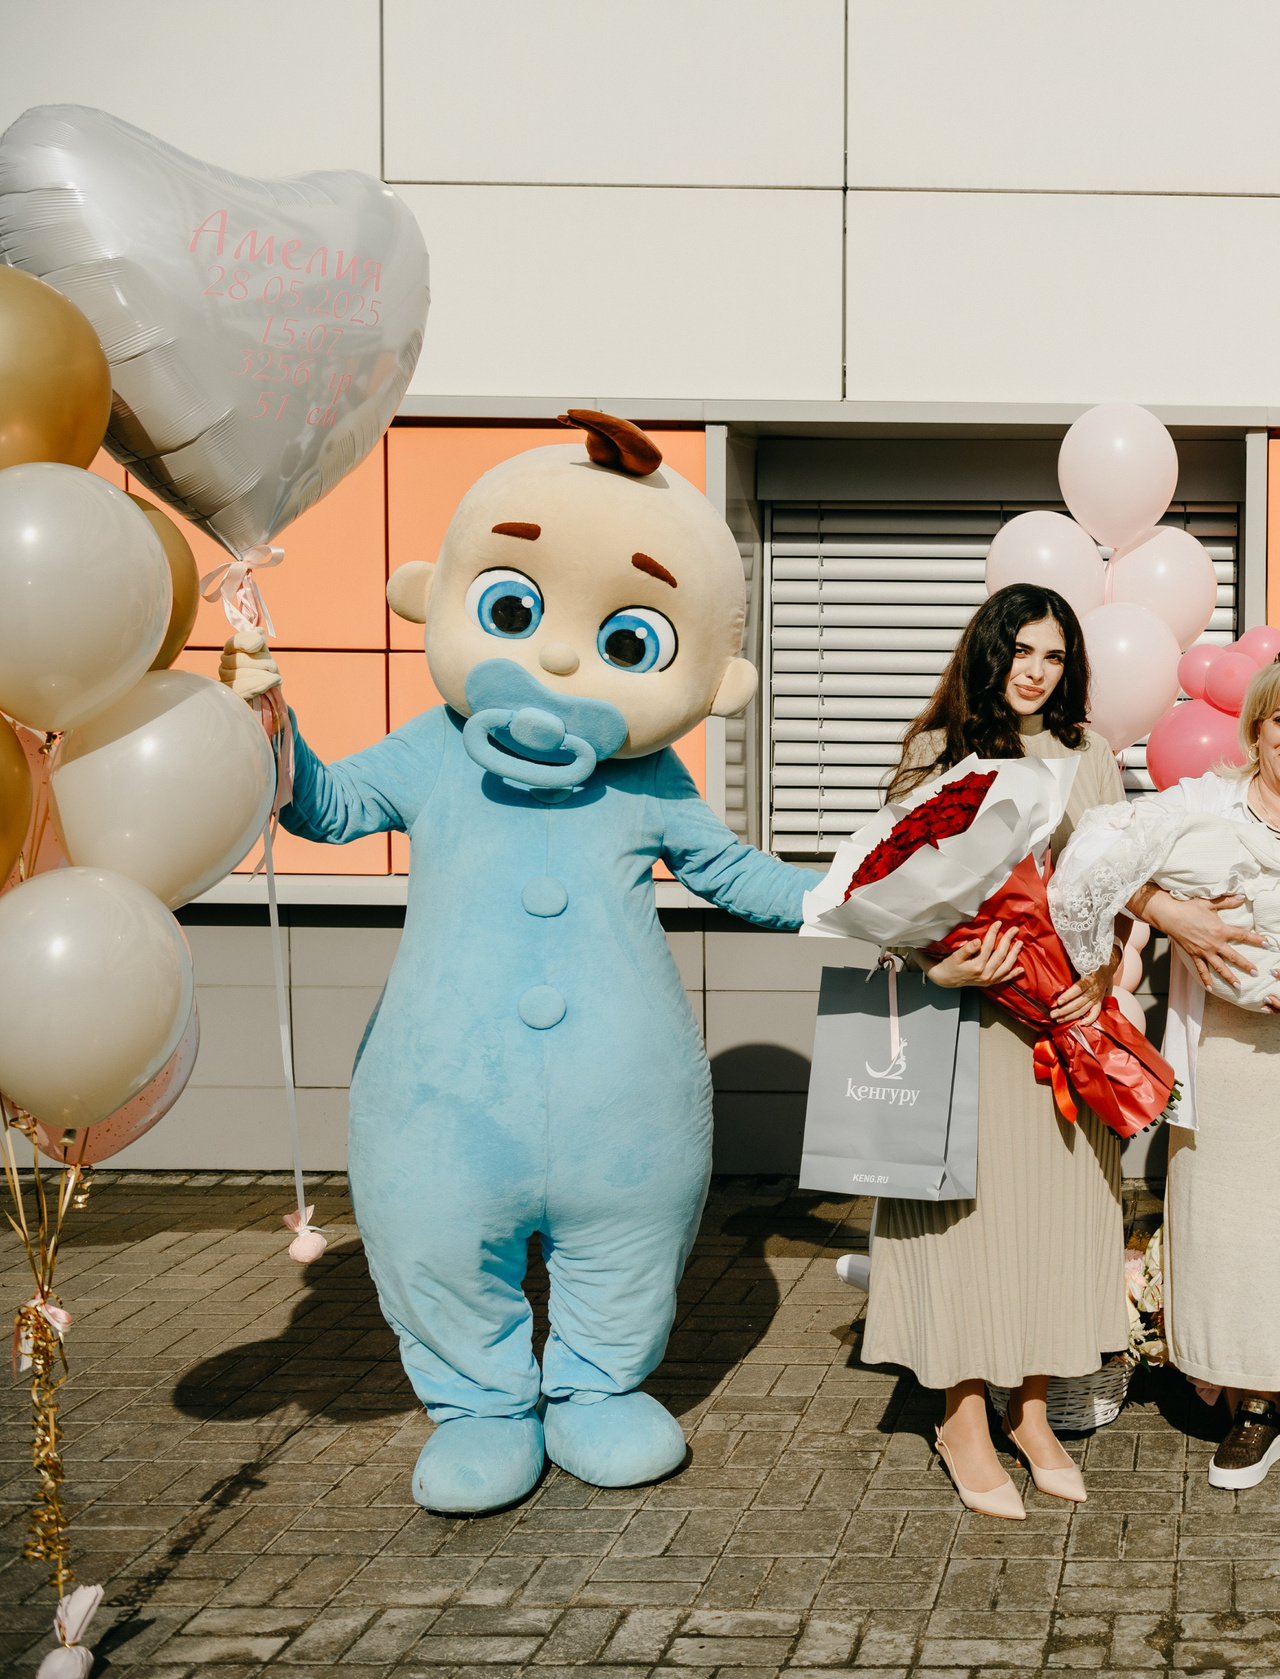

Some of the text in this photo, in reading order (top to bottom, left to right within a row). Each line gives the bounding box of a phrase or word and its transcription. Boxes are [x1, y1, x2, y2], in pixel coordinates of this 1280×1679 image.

[189, 209, 382, 292] Амелия
[203, 265, 382, 327] 28.05.2025
[260, 314, 344, 356] 15:07
[230, 350, 314, 386] 3256
[249, 392, 338, 427] 51 см
[852, 1173, 889, 1184] KENG.RU
